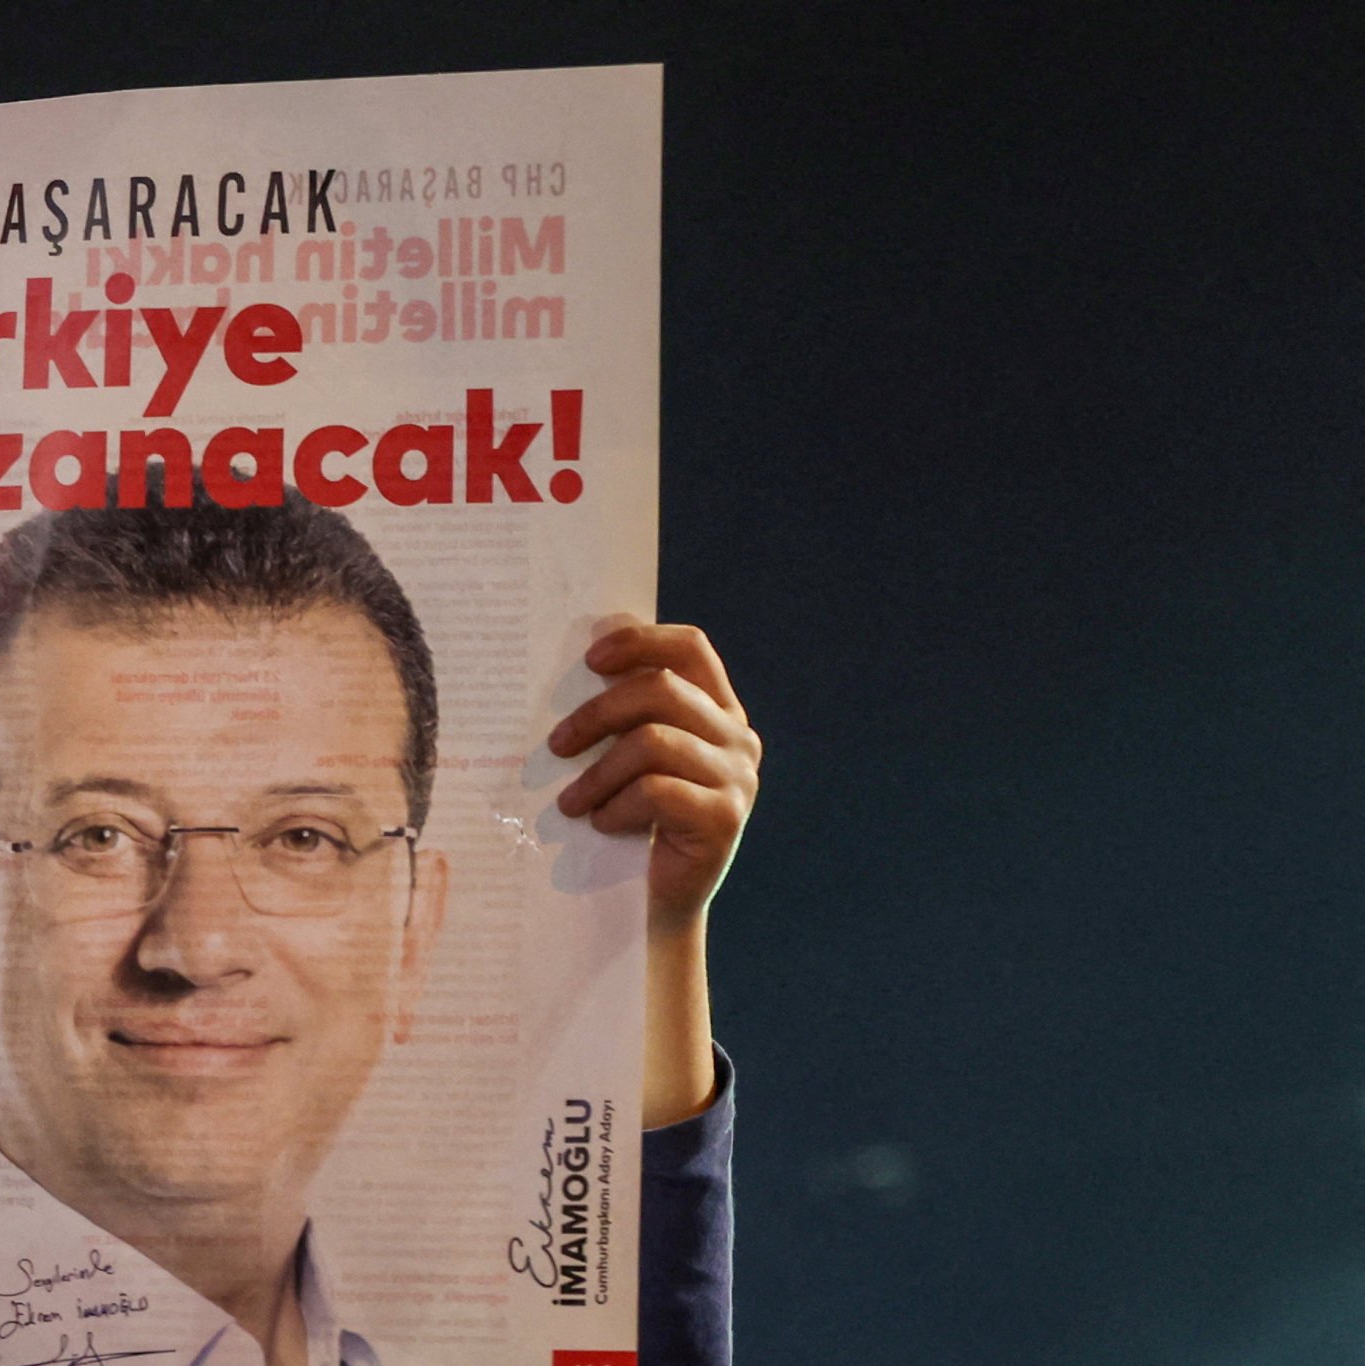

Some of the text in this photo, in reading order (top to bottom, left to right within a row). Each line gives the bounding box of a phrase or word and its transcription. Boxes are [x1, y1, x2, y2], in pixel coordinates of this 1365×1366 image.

[553, 1098, 591, 1308] İMAMOĞLU
[594, 1099, 616, 1306] Cumhurbaşkanı Aday Adayı
